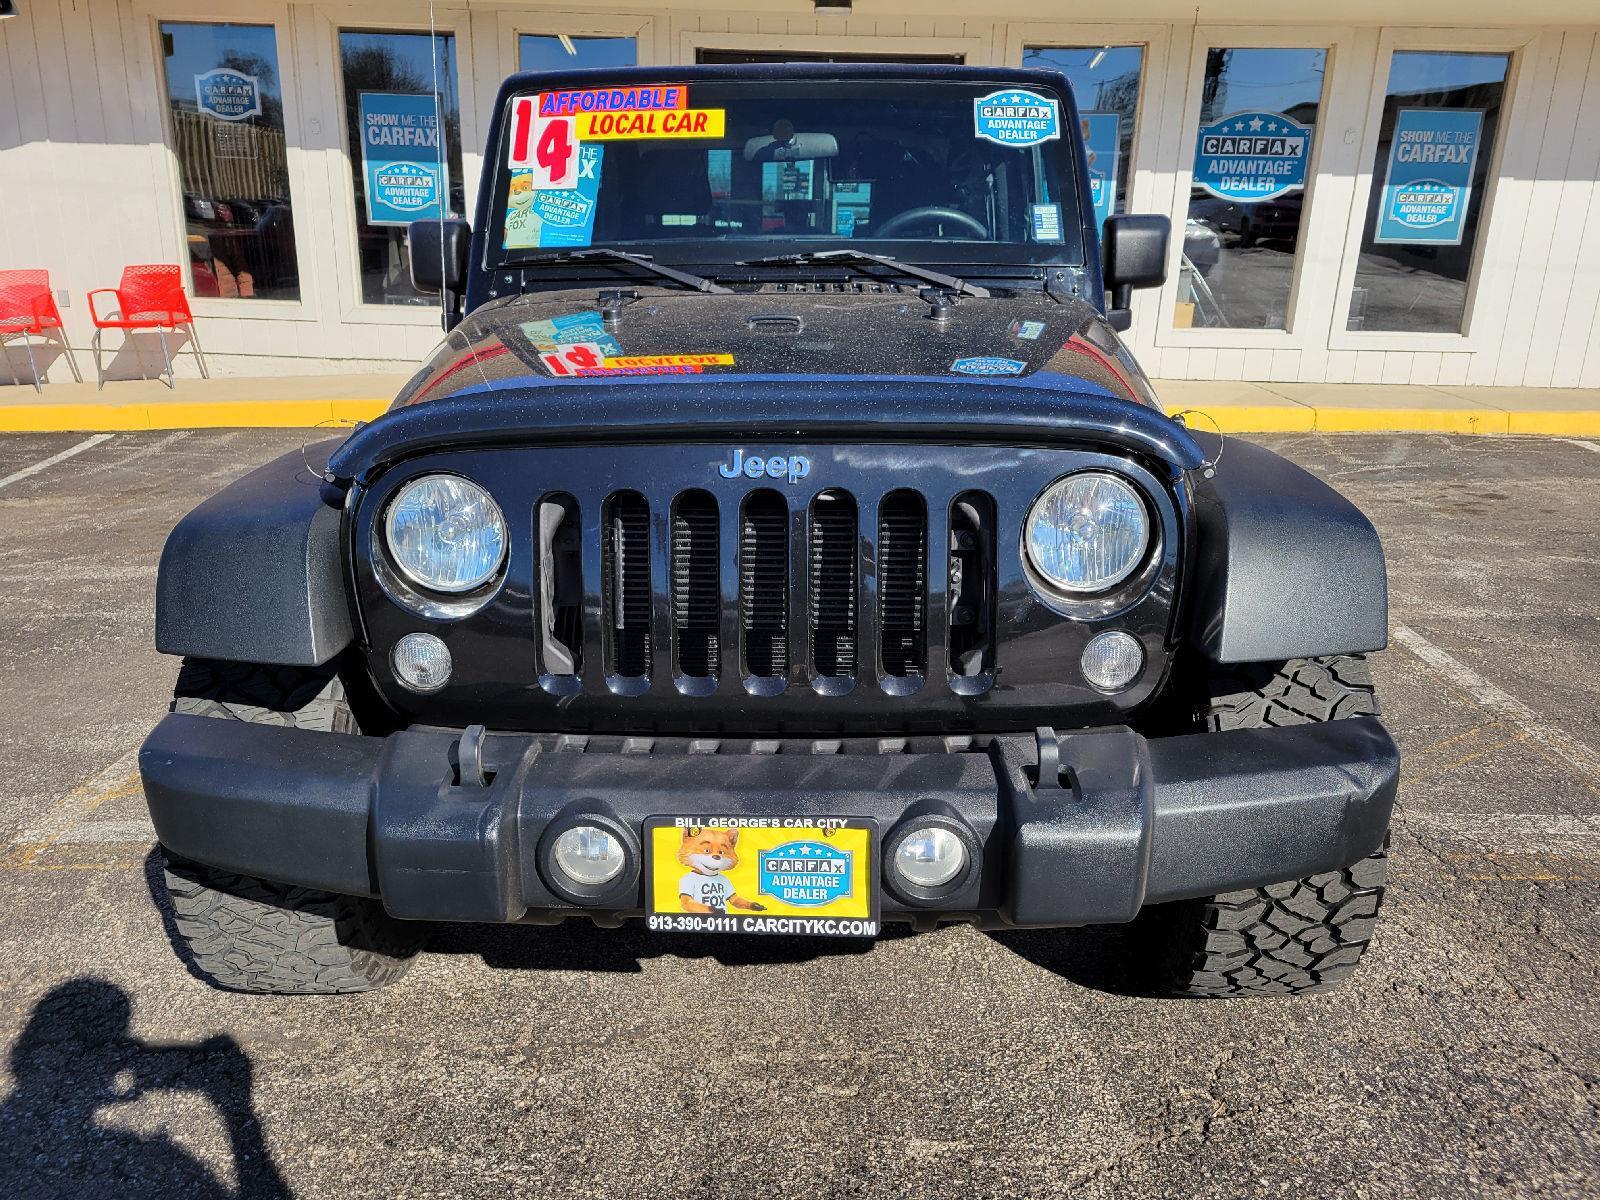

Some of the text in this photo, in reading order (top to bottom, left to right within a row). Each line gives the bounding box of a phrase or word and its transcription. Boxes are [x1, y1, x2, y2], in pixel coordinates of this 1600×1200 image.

[204, 86, 252, 96] CARFAX
[208, 96, 250, 104] ADVANTAGE
[541, 88, 680, 114] AFFORDABLE
[216, 105, 244, 113] DEALER
[982, 106, 1050, 119] CARFAX
[366, 113, 437, 127] SHOW ME THE
[588, 112, 708, 135] LOCAL CAR
[987, 119, 1047, 130] ADVANTAGE
[367, 126, 439, 147] CARFAX
[998, 130, 1038, 140] DEALER
[1400, 130, 1474, 144] SHOW ME THE
[1205, 138, 1300, 156] CARFAX
[1397, 143, 1473, 163] CARFAX
[1207, 159, 1292, 175] ADVANTAGE
[380, 175, 432, 187] CARFAX
[1220, 176, 1276, 191] DEALER
[384, 187, 430, 197] ADVANTAGE
[1399, 193, 1451, 204] CARFAX
[392, 197, 422, 205] DEALER
[540, 193, 585, 213] CARFAX
[509, 208, 529, 221] CAR
[539, 204, 580, 220] ADVANTAGE
[1400, 204, 1448, 214] ADVANTAGE
[543, 212, 571, 225] DEALER
[1406, 213, 1437, 222] DEALER
[719, 448, 811, 485] Jeep
[675, 817, 848, 829] BILL GEORGE'S CAR CITY
[766, 860, 843, 873] CARFAX
[772, 875, 839, 888] ADVANTAGE
[701, 883, 725, 895] CAR
[783, 888, 828, 900] DEALER
[701, 895, 725, 907] FOX
[649, 915, 876, 936] 913-390-0111 CARCITYKC.COM
